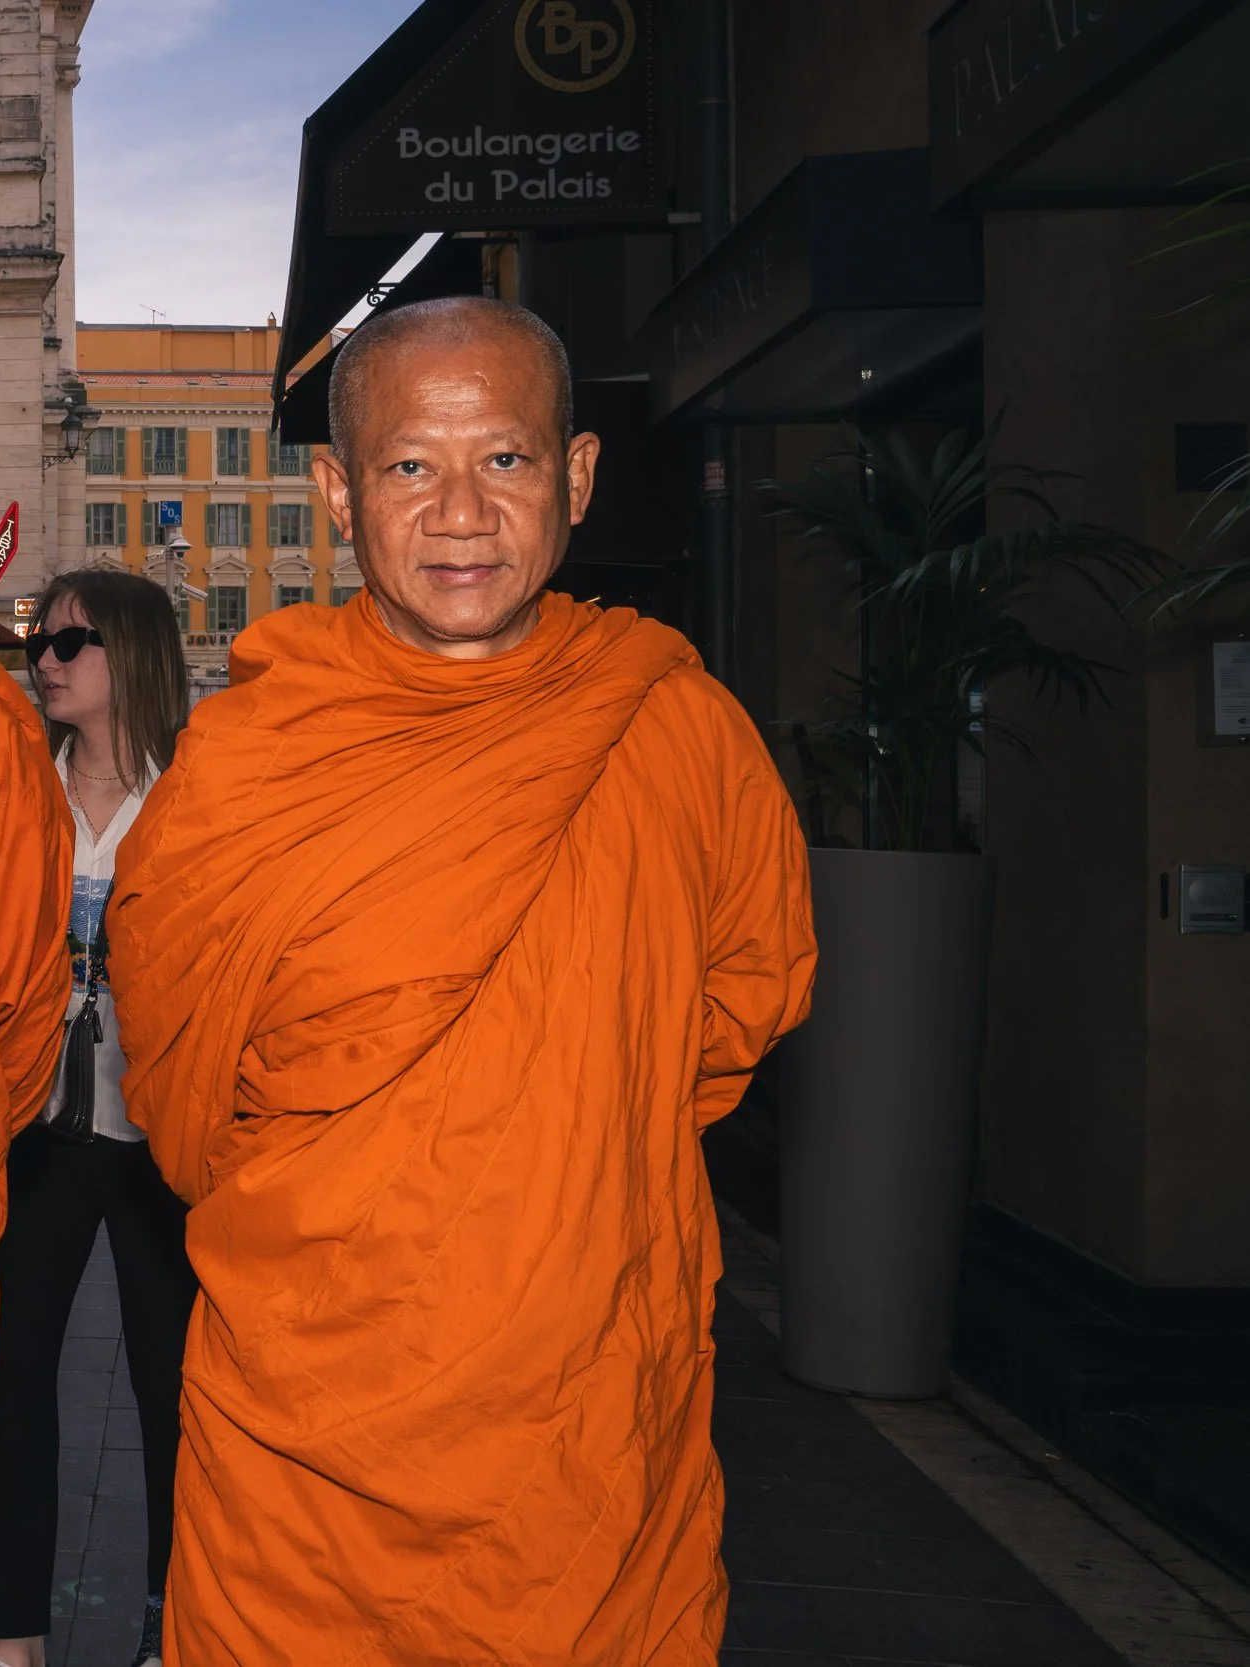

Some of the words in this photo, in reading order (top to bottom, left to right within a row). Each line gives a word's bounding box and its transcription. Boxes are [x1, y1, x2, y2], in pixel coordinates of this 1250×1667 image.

[395, 125, 642, 165] Boulangerie
[424, 171, 474, 203] du
[491, 168, 612, 201] Palais
[161, 501, 181, 524] SOS
[187, 634, 236, 647] JOUR
